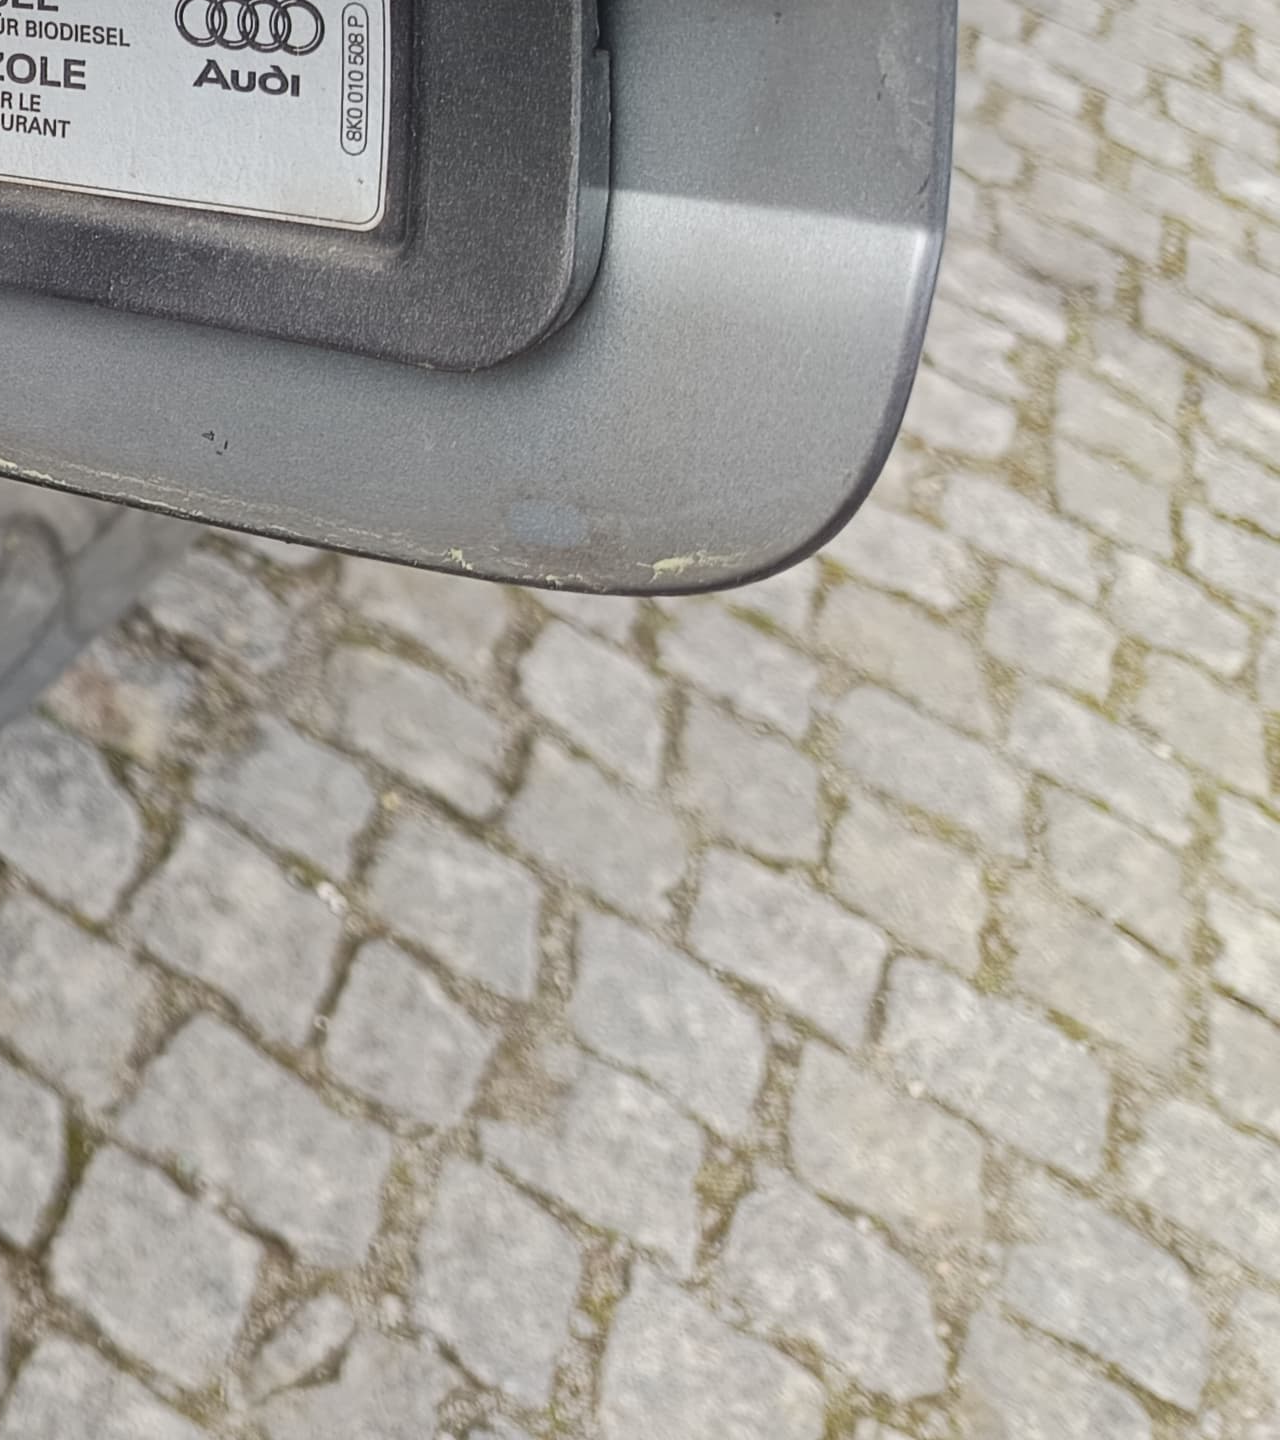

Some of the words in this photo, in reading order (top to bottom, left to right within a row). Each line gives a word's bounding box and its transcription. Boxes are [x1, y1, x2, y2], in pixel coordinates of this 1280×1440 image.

[25, 20, 131, 47] BIODIESEL
[347, 15, 365, 28] P
[348, 32, 365, 66] 508
[192, 58, 300, 97] Audi
[347, 70, 364, 103] 010
[19, 93, 41, 113] LE
[346, 107, 363, 142] 8K0
